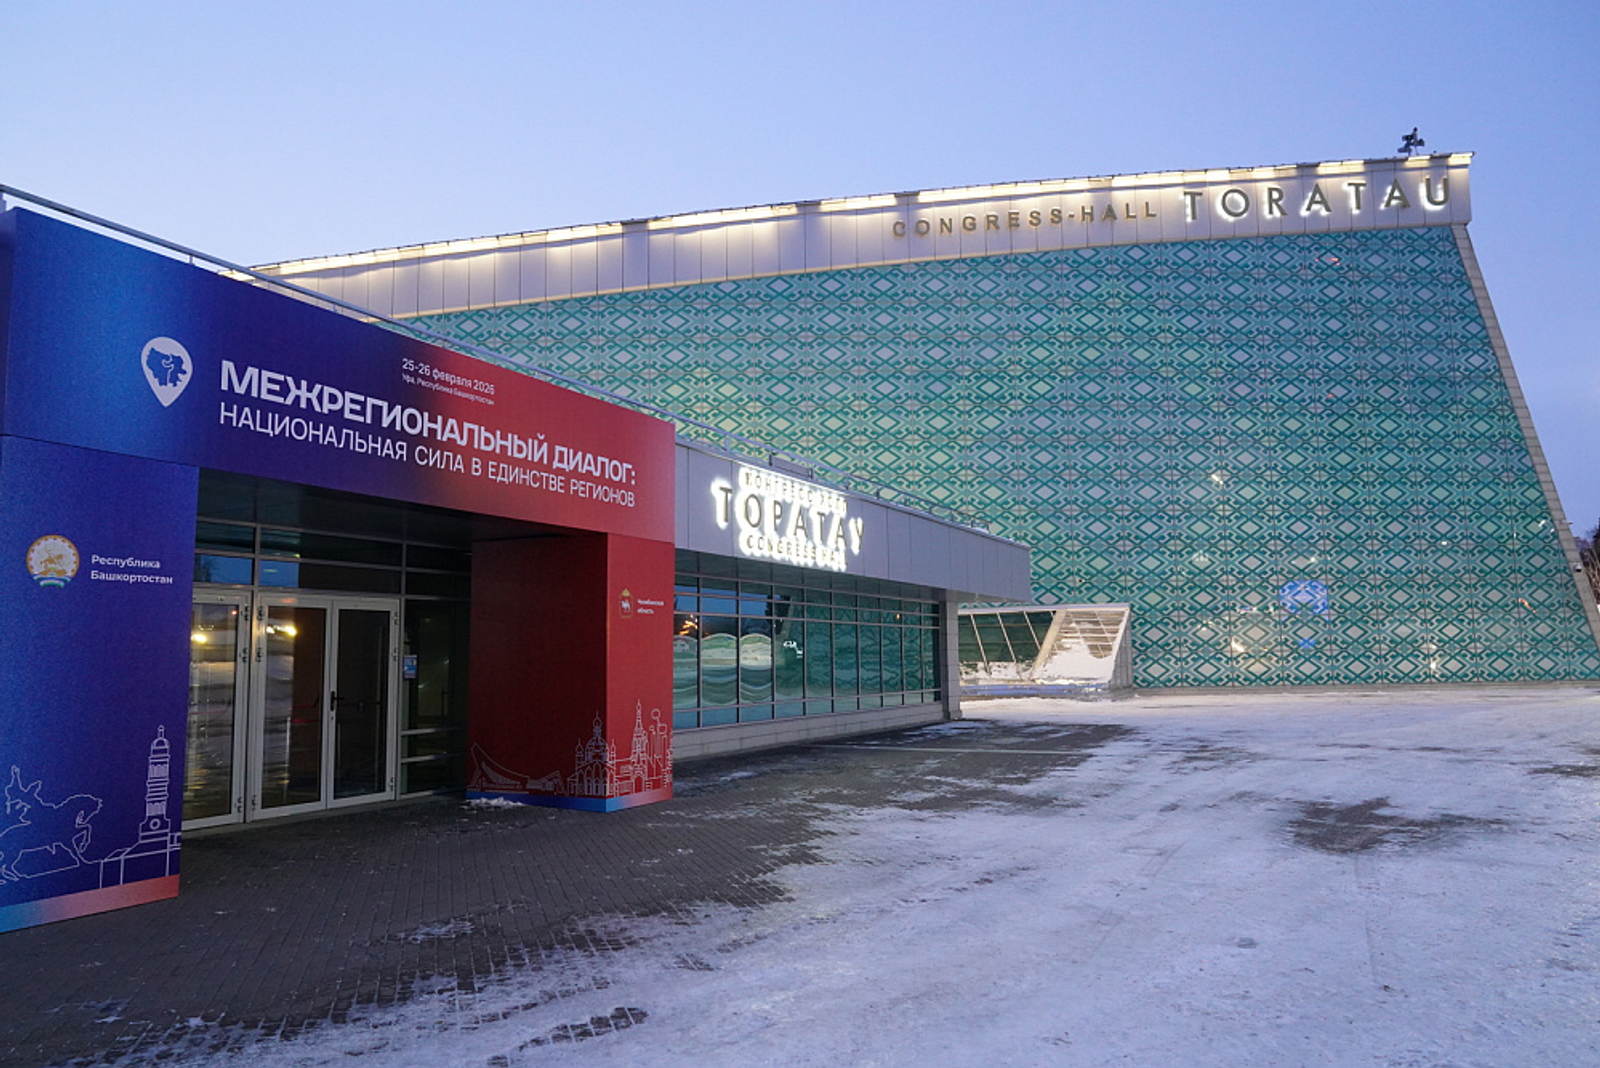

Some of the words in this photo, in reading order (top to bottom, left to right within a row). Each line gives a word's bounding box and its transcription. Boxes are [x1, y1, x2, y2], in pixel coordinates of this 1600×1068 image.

[892, 201, 1158, 237] CONGRESS-HALL
[1182, 174, 1449, 221] TORATAU
[401, 357, 431, 376] 25-26
[432, 367, 472, 389] февраля
[220, 359, 549, 465] МЕЖРЕГИОНАЛЬНЫЙ
[552, 445, 636, 486] ДИАЛОГ:
[219, 401, 407, 462] НАЦИОНАЛЬНАЯ
[414, 445, 465, 474] СИЛА
[471, 457, 482, 476] В
[488, 461, 565, 494] ЕДИНСТВЕ
[570, 478, 635, 508] РЕГИОНОВ
[718, 485, 865, 551] ТОРАТАУ
[91, 554, 161, 569] Республика
[746, 534, 817, 561] CONGRESS
[90, 570, 173, 585] Башкортостан
